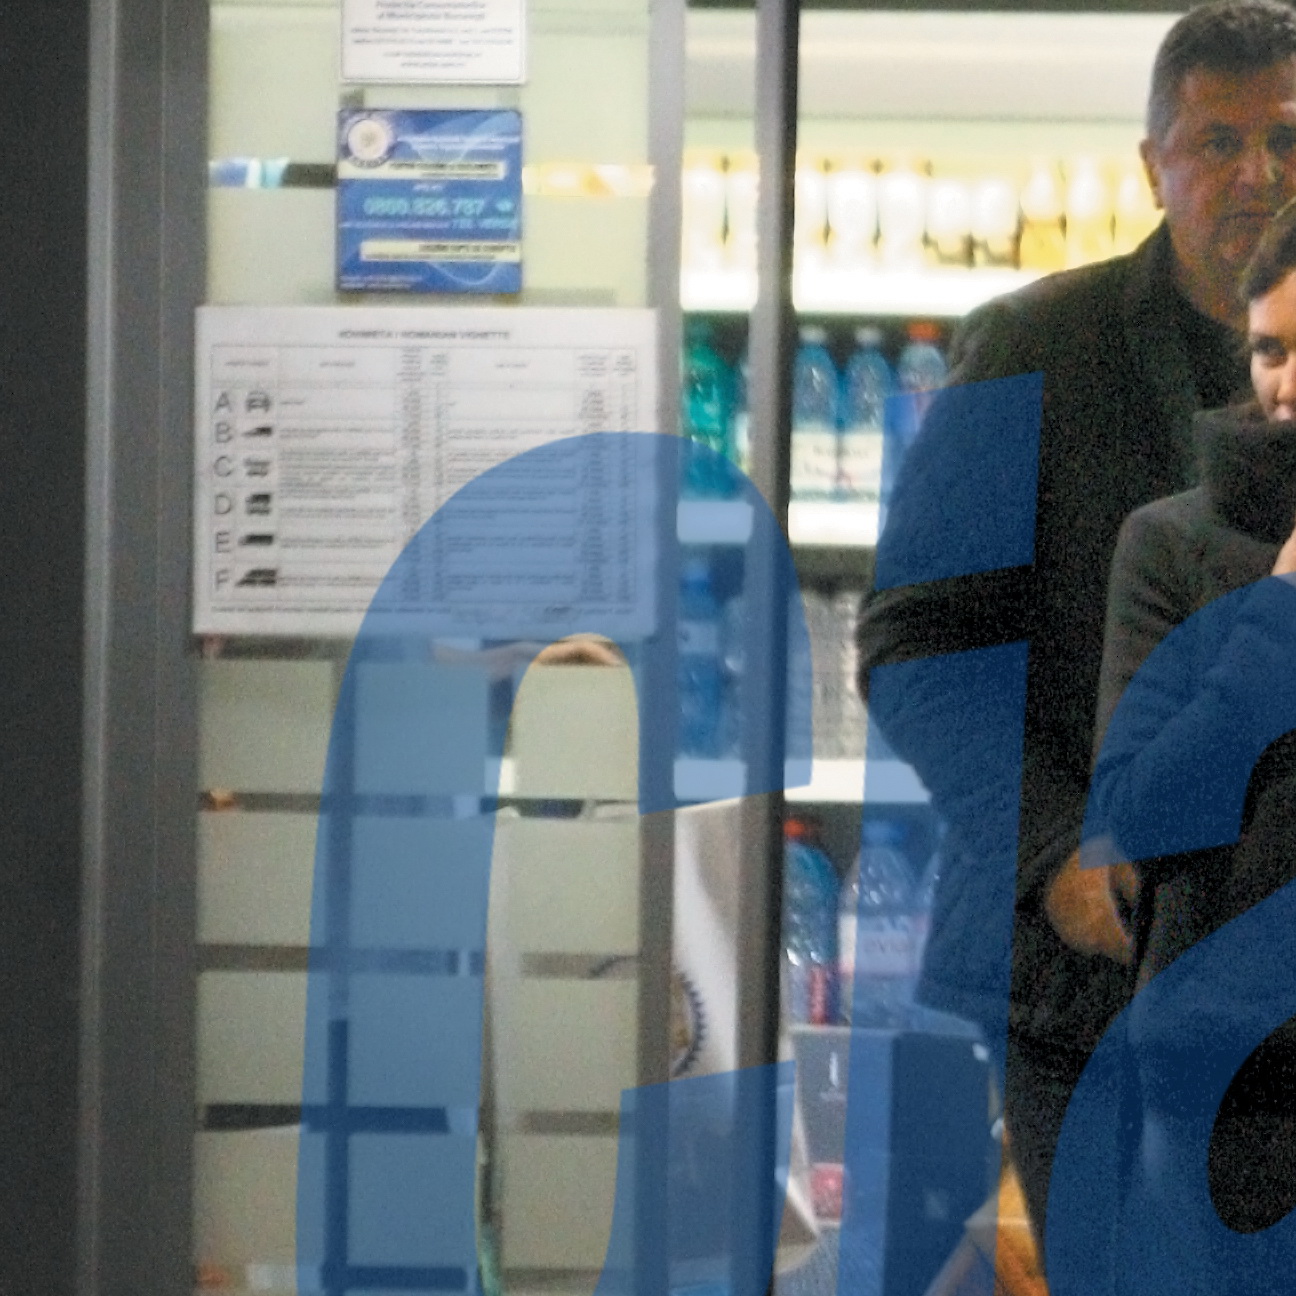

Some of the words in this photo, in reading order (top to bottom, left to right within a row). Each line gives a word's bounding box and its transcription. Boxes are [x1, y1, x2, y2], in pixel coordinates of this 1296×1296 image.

[213, 391, 233, 414] A
[214, 423, 232, 445] B
[213, 455, 233, 479] C
[214, 493, 232, 515] D
[214, 531, 231, 554] E
[215, 570, 231, 593] F
